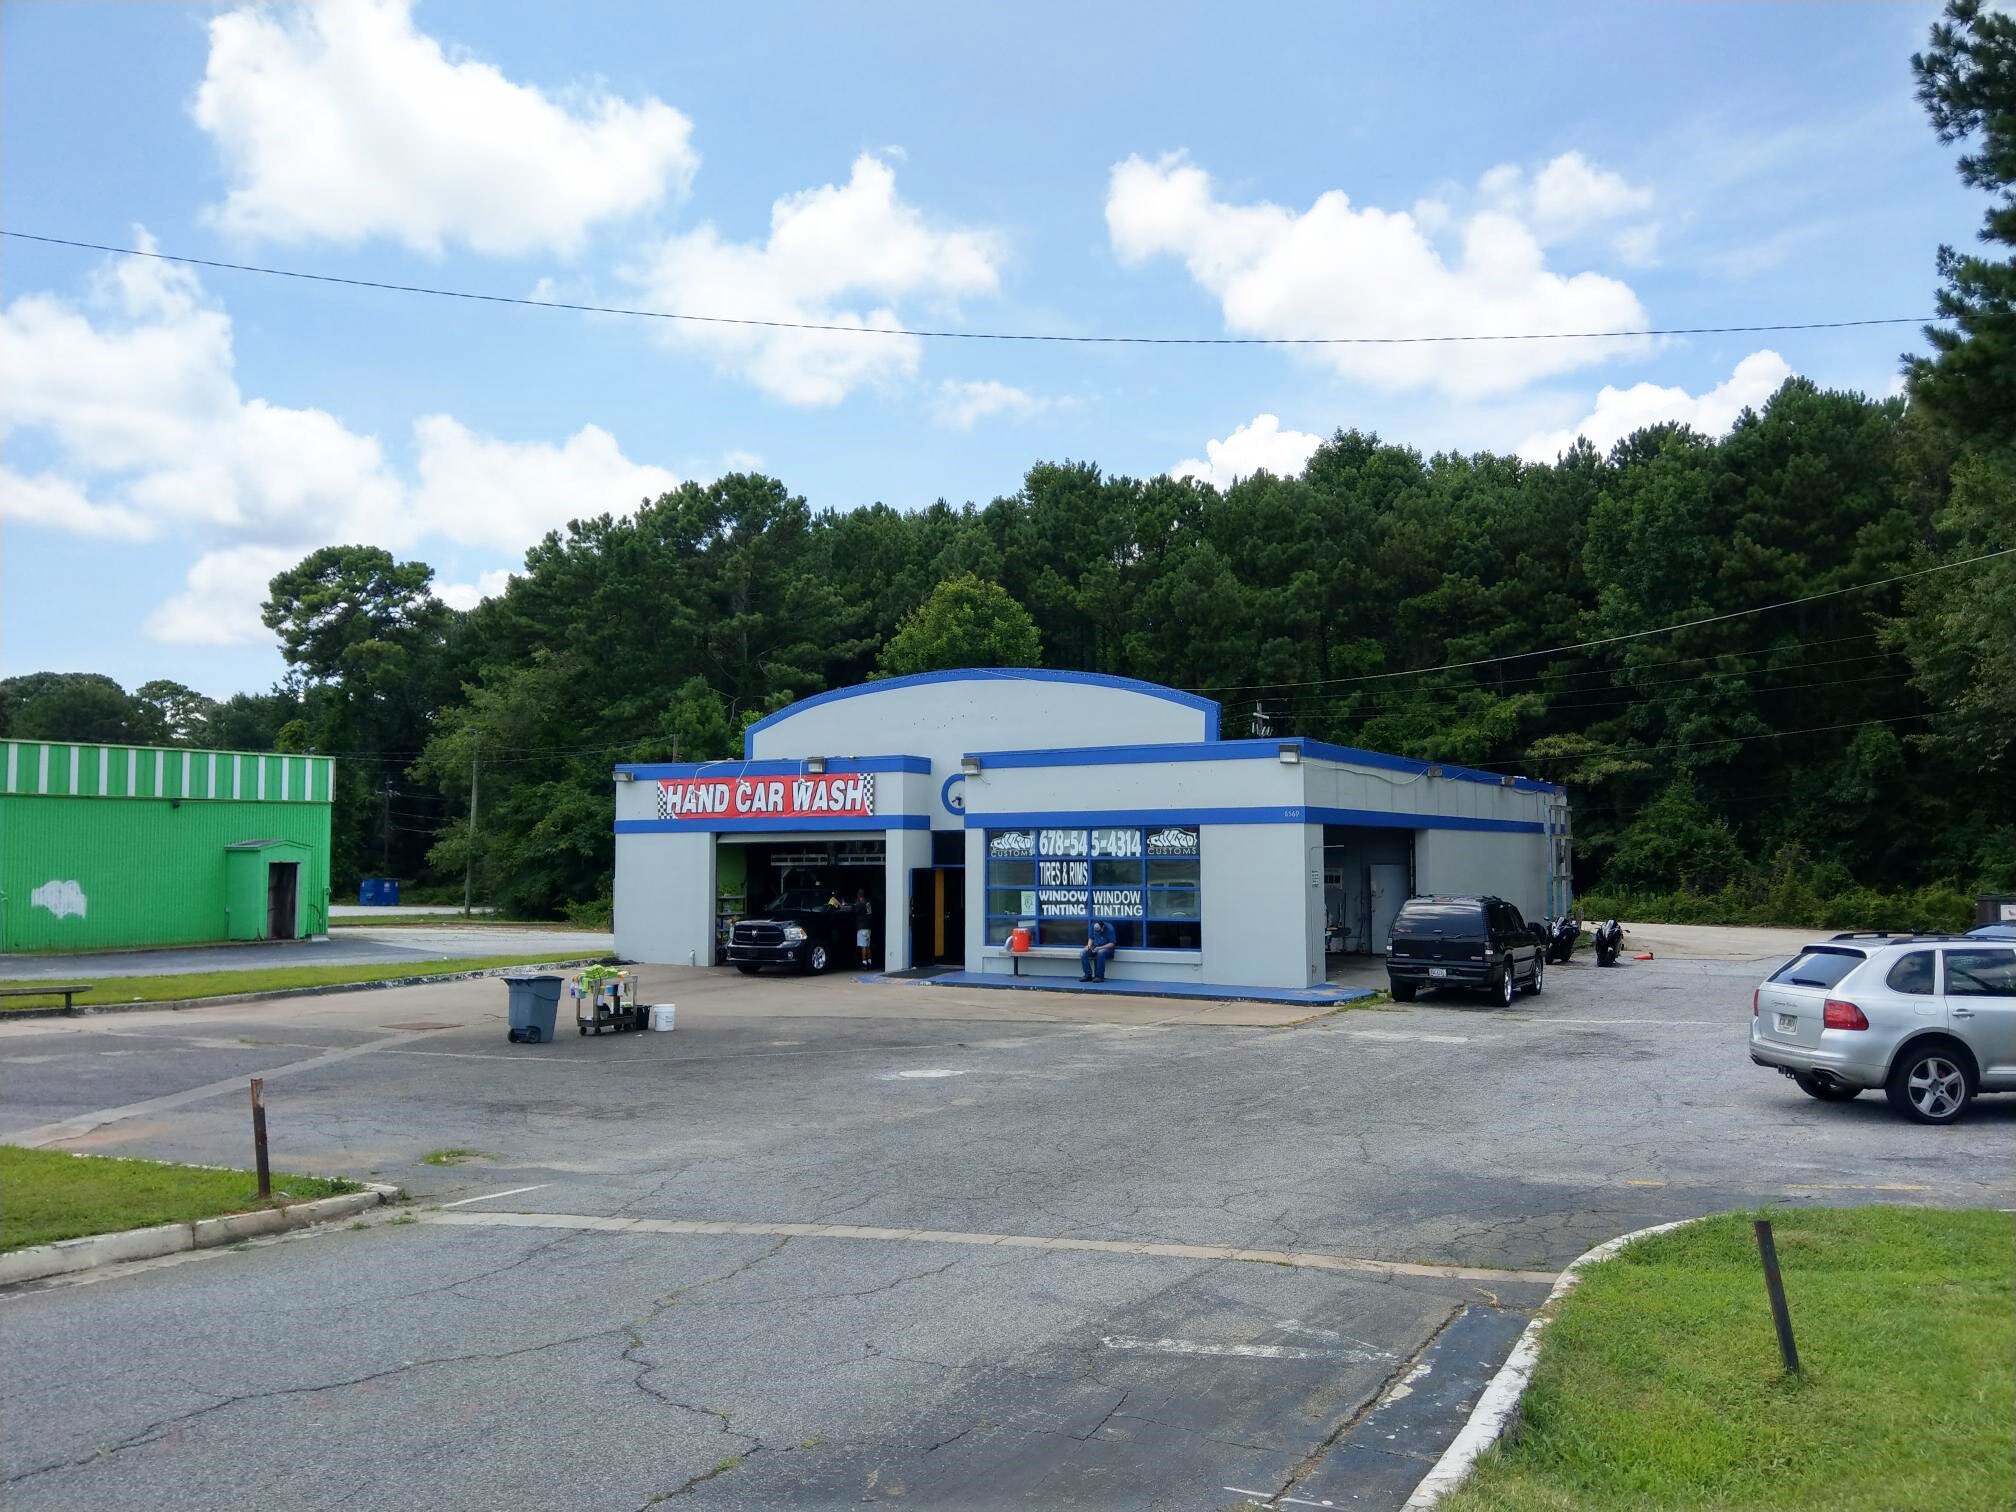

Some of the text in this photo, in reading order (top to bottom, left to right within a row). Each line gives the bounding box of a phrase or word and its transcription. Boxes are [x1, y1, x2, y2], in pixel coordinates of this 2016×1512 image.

[666, 778, 864, 814] HAND CAR WASH
[1148, 847, 1197, 855] CUSTOMS
[1039, 861, 1088, 886] TIRES & RIMS
[1039, 890, 1088, 902] WINDOW
[1093, 890, 1141, 904] WINDOW
[1042, 904, 1086, 916] TINTING
[1093, 904, 1143, 916] TINTING
